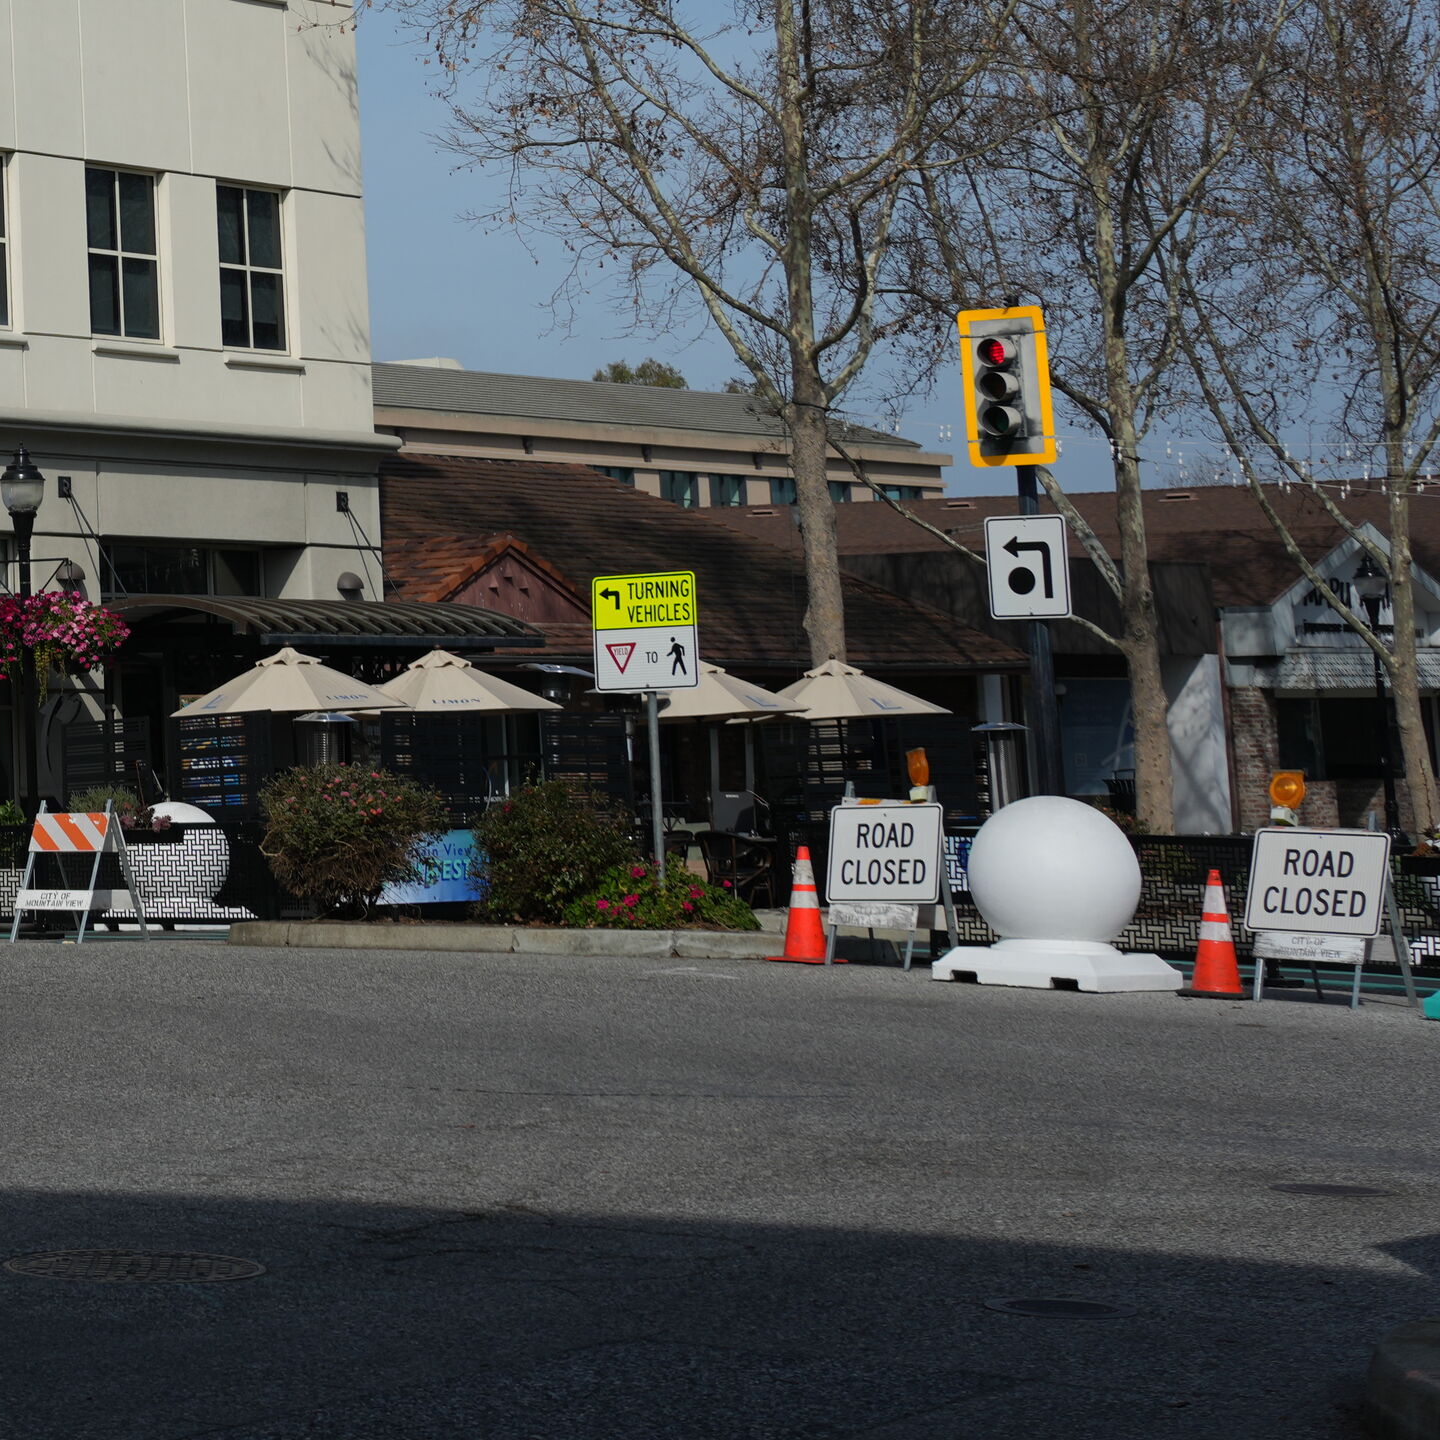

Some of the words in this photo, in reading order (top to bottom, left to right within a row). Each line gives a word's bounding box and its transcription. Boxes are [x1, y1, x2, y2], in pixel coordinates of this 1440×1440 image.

[627, 580, 690, 600] TURNING
[627, 603, 691, 623] VEHICLES
[613, 647, 629, 656] YIELD
[645, 651, 659, 664] TO
[856, 823, 915, 849] ROAD
[841, 859, 927, 885] CLOSED
[1283, 848, 1355, 878] ROAD
[25, 900, 64, 908] MOUNTAIN
[65, 900, 84, 908] VIEW
[40, 892, 59, 900] CITY
[61, 892, 71, 900] OF
[1263, 886, 1367, 918] CLOSED
[1291, 936, 1311, 945] CITY
[1314, 938, 1327, 947] OF
